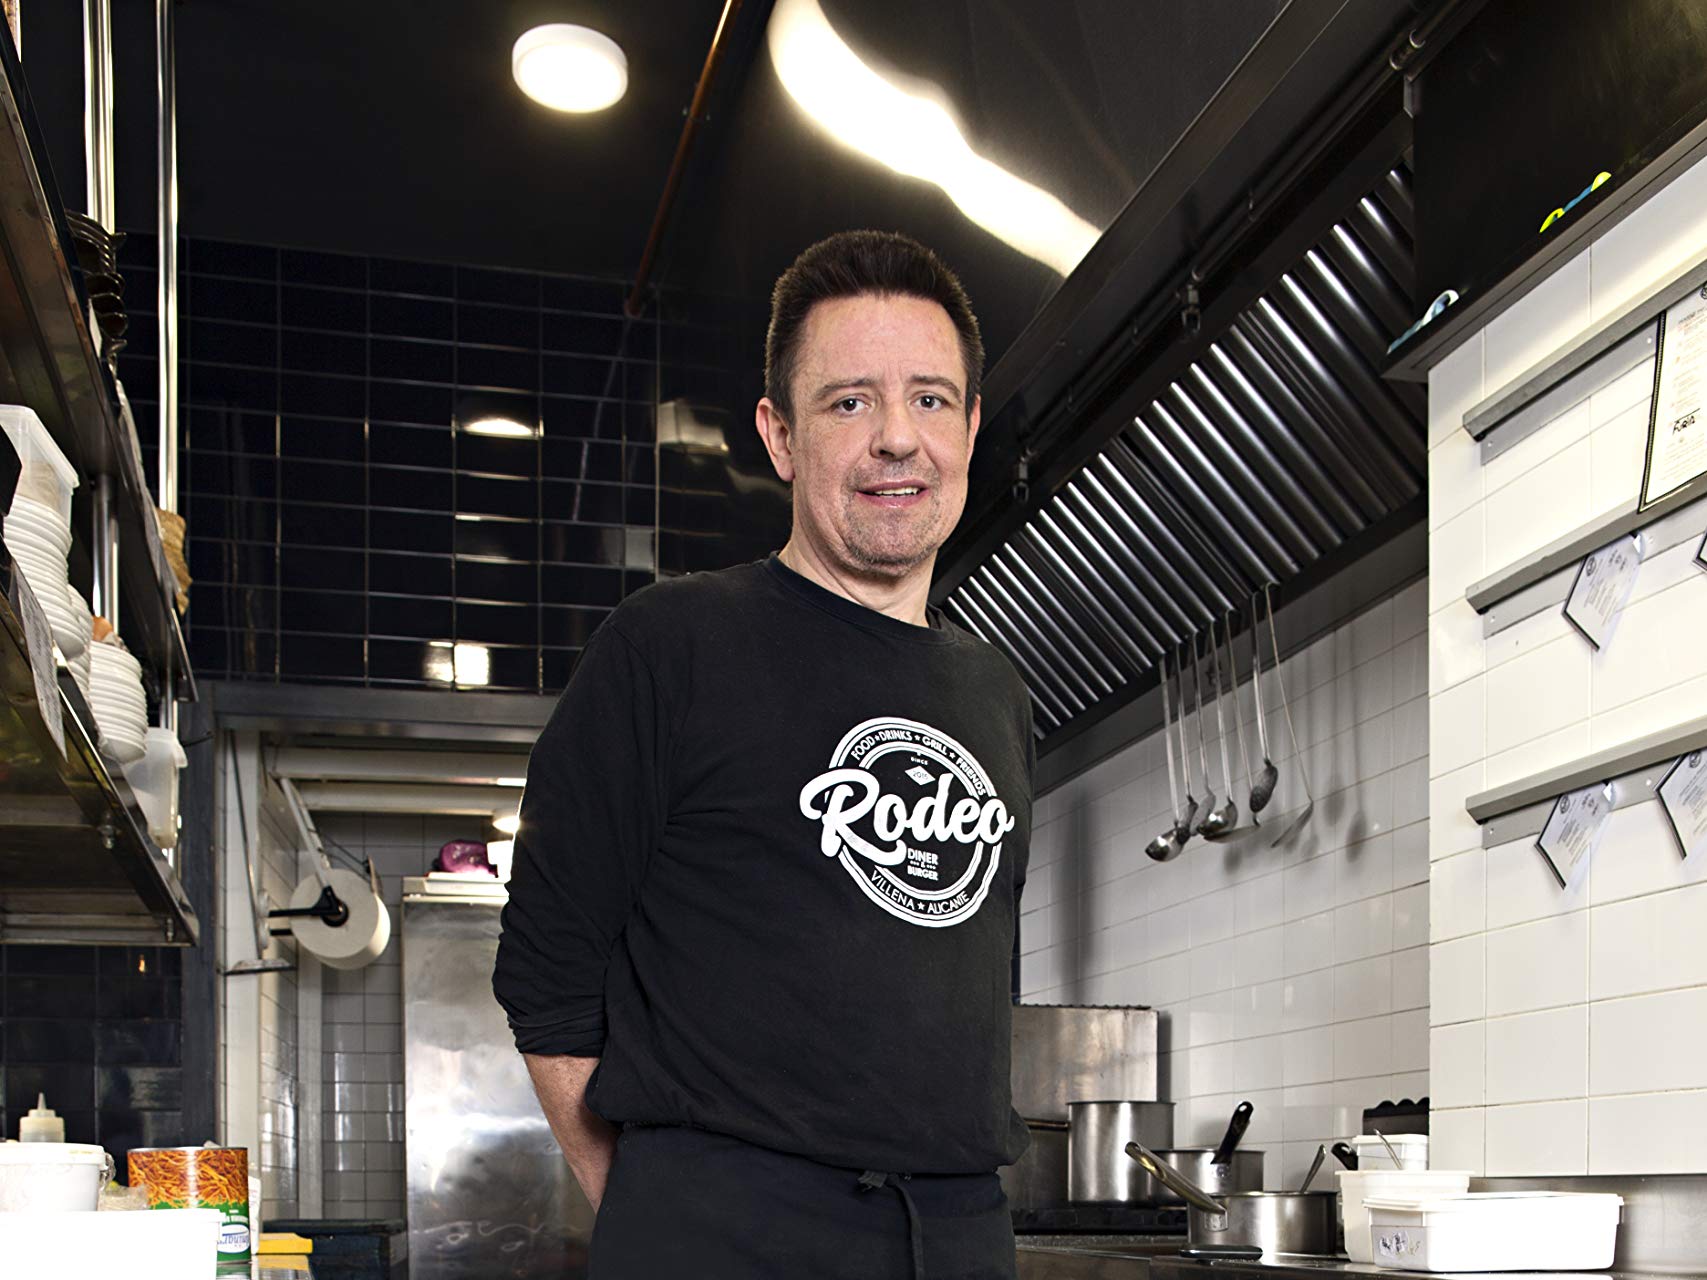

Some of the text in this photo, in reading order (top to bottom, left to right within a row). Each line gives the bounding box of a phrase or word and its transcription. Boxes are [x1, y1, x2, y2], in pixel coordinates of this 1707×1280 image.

[850, 729, 987, 796] FOOD DRINKS GRILL FRIENDS
[799, 768, 1015, 866] Rodeo
[907, 847, 939, 866] DINER
[907, 865, 939, 881] BURGER
[870, 869, 971, 915] VILLENA ALICANTE
